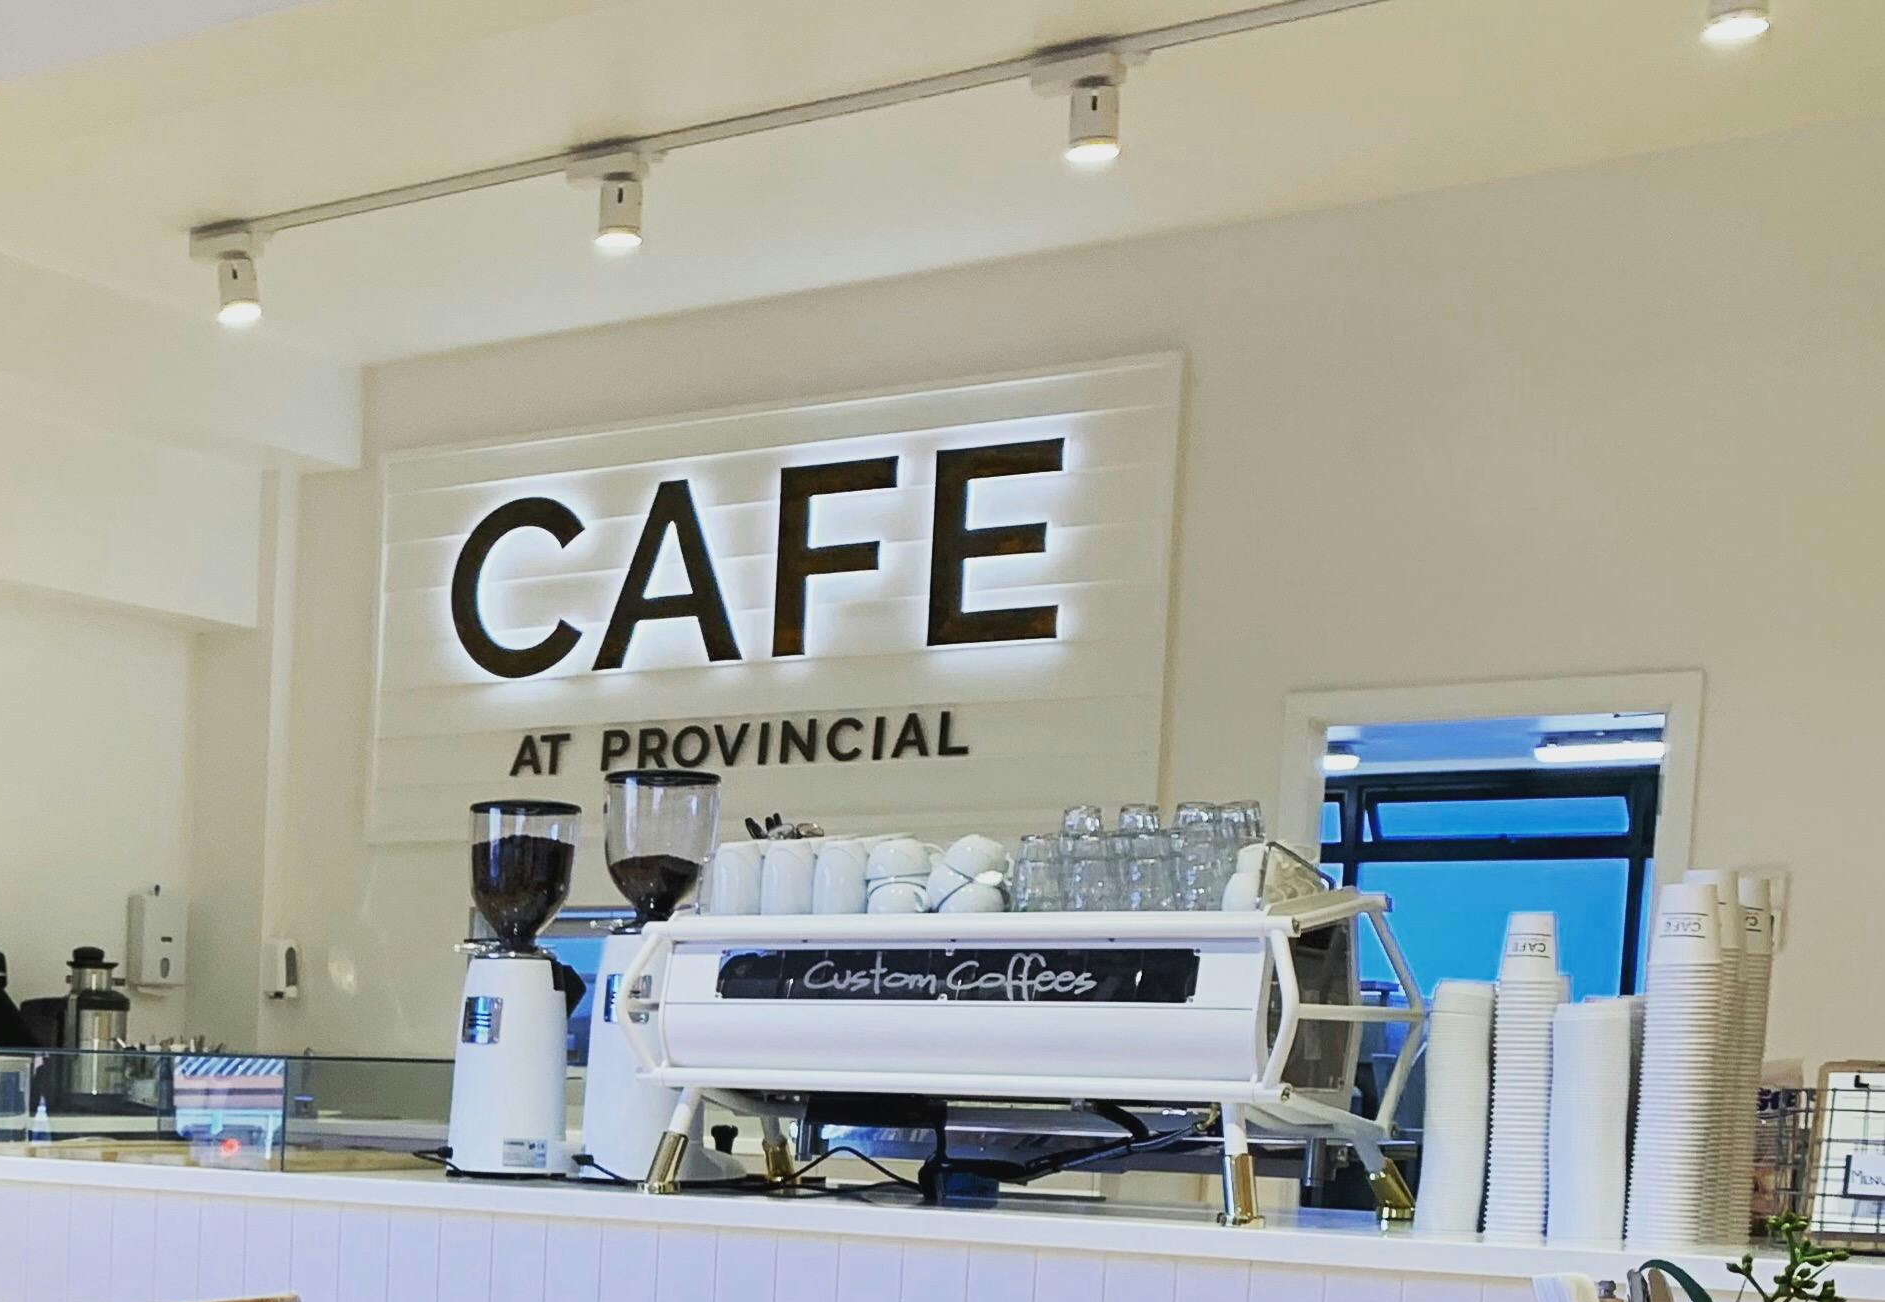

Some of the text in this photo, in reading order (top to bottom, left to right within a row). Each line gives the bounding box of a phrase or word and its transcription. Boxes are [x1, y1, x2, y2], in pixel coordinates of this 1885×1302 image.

[450, 437, 1066, 680] CAFE
[510, 710, 970, 777] AT PROVINCIAL
[802, 952, 1098, 1002] Custom Coffees
